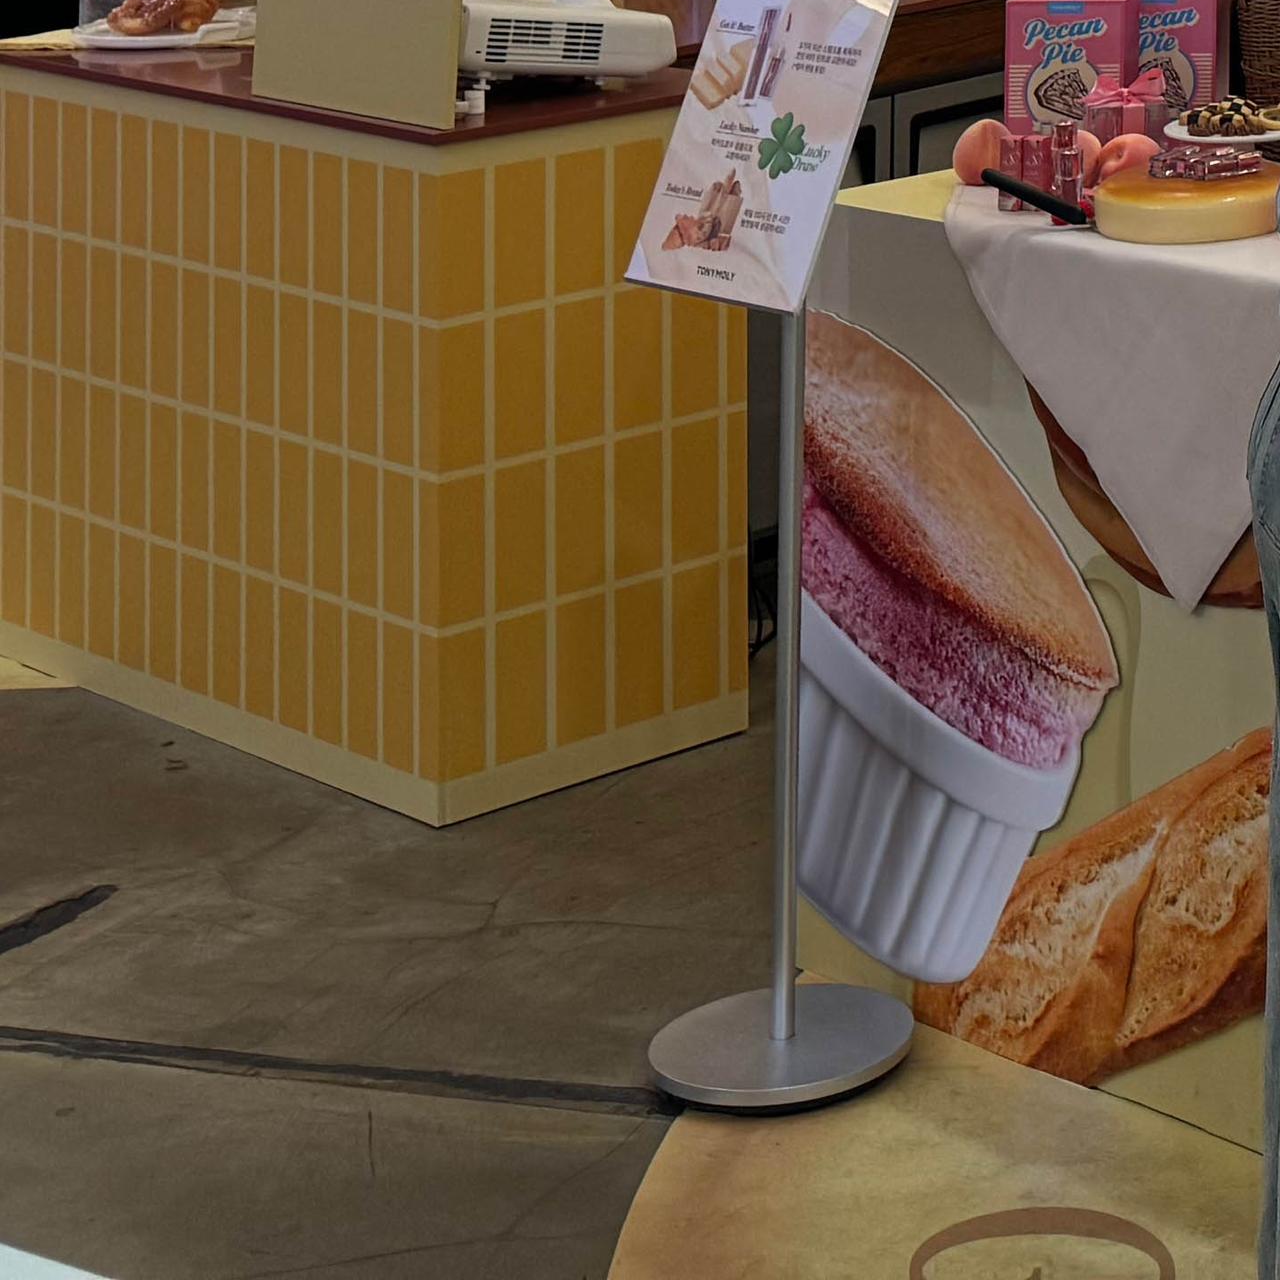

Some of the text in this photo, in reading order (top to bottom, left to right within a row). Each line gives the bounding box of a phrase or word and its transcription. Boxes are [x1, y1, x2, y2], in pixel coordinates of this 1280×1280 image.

[1025, 17, 1107, 47] Pecan
[1140, 8, 1197, 31] ecan
[1042, 41, 1086, 69] Pie
[1140, 31, 1177, 54] Pie
